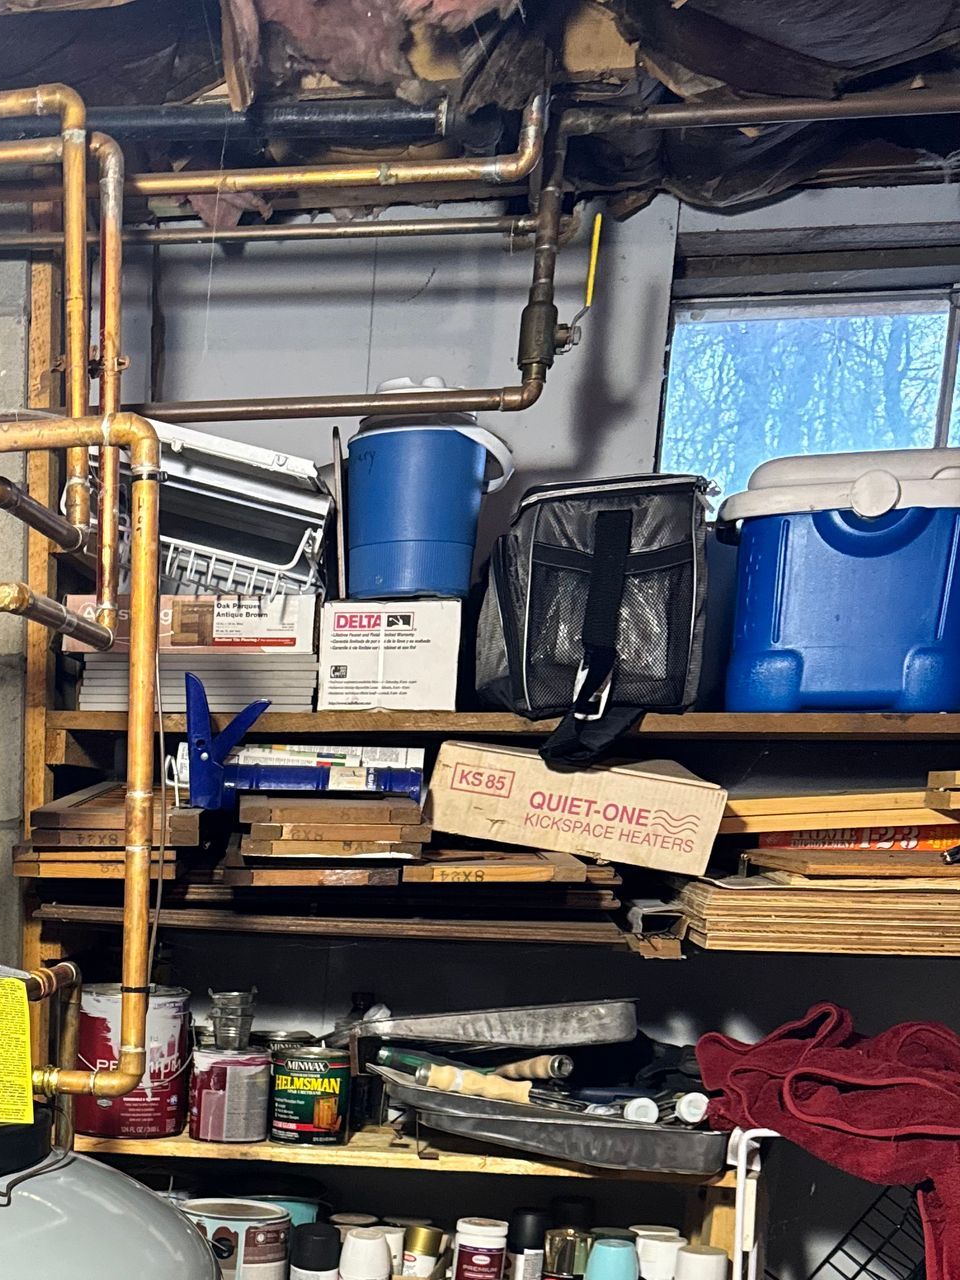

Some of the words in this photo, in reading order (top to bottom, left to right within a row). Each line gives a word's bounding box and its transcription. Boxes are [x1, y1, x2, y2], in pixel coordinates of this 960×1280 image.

[336, 614, 381, 629] DELTA
[459, 769, 483, 787] KS
[486, 774, 507, 791] 85
[529, 791, 652, 827] QUIET-ONE
[524, 812, 615, 840] KICKSPACE
[618, 828, 695, 854] HEATERS
[440, 870, 486, 882] 8X24
[287, 1060, 326, 1072] MINWAX
[275, 1074, 341, 1094] HELMSMAN
[462, 1264, 498, 1273] PREMIUM
